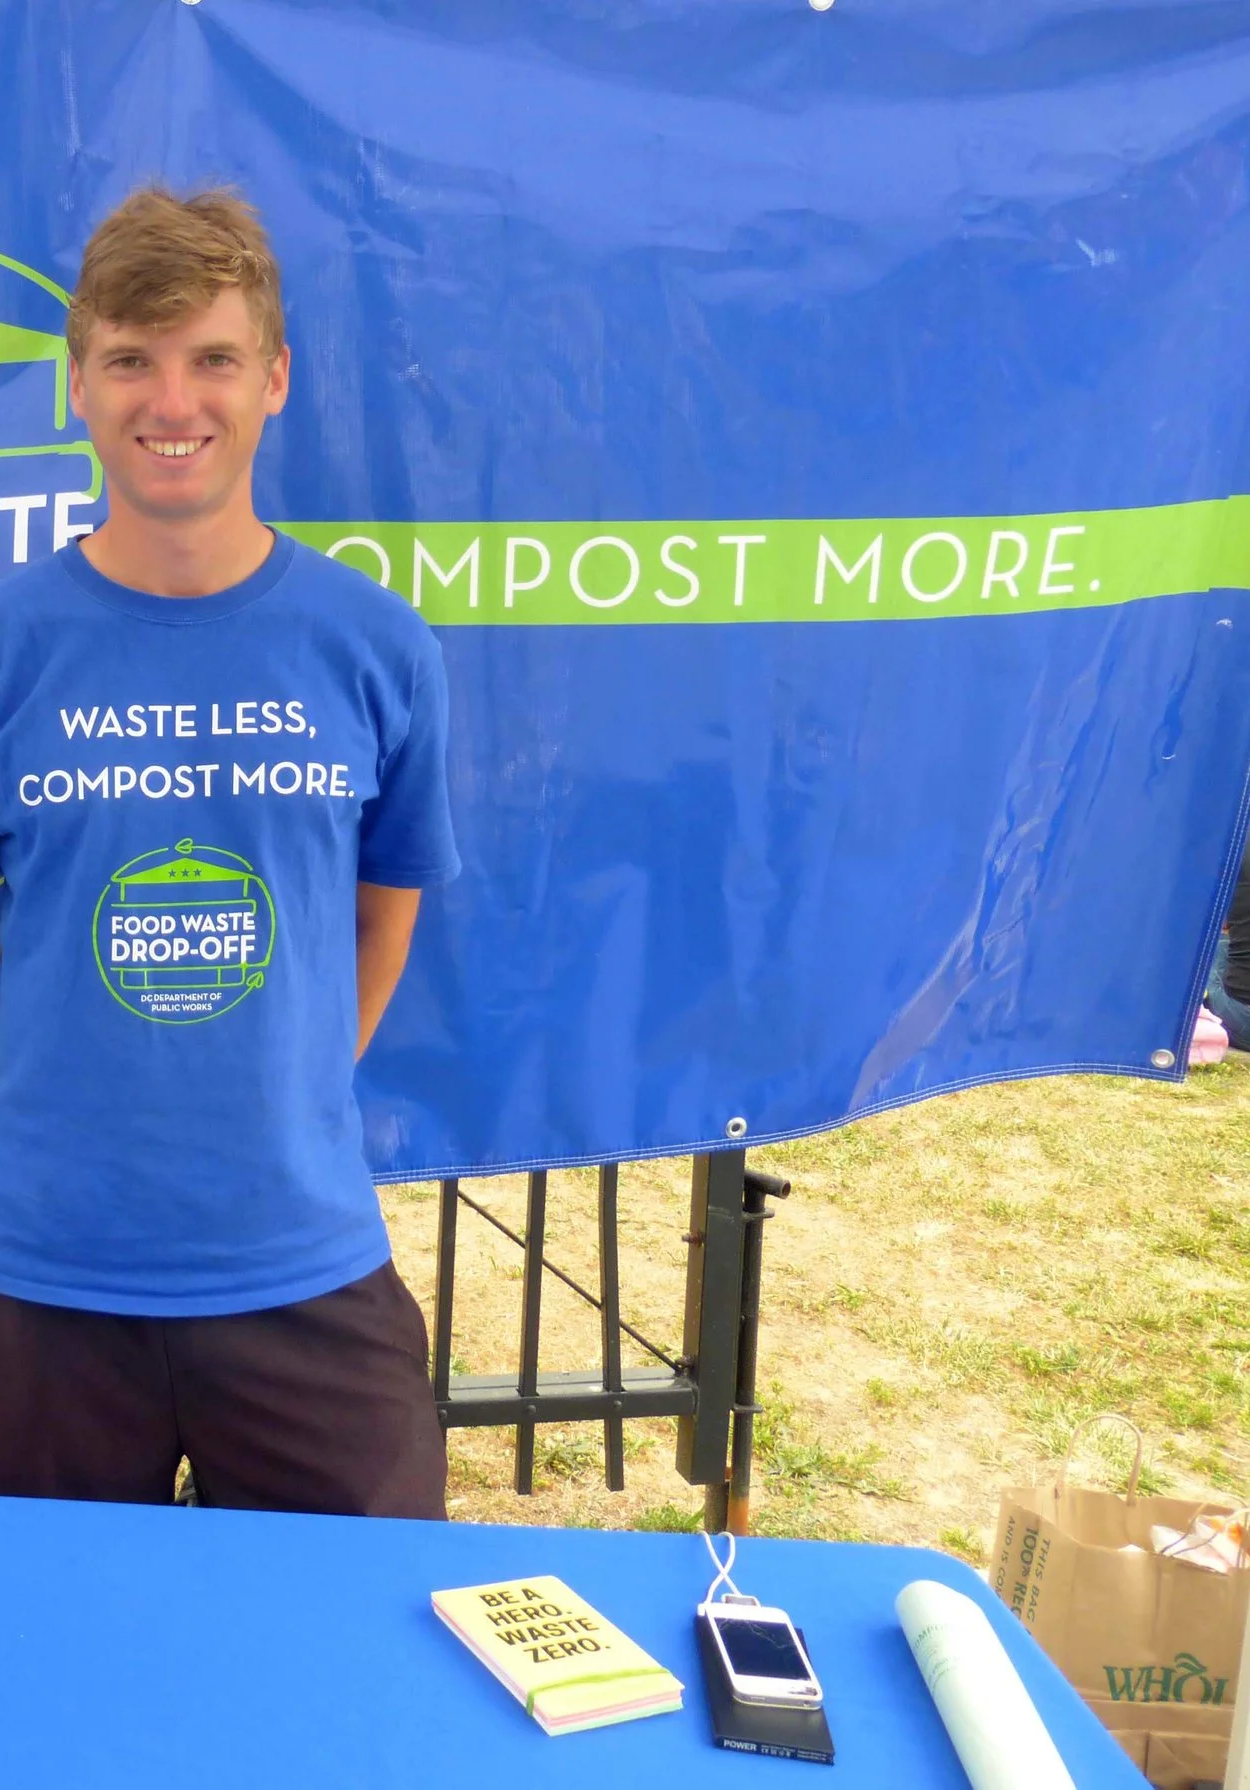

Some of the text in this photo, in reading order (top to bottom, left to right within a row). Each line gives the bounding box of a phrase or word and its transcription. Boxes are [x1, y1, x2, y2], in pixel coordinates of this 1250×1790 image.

[814, 525, 1101, 605] MORE.
[59, 700, 317, 740] WASTE LESS,
[18, 761, 356, 807] COMPOST MORE.
[111, 911, 256, 935] FOOD WASTE
[110, 934, 256, 964] DROP-OFF
[140, 992, 223, 1002] DC DEPARTMENT OF
[151, 1003, 213, 1012] PUBLIC WORKS
[1005, 1516, 1015, 1546] AND
[1001, 1550, 1010, 1564] IS
[1020, 1527, 1039, 1577] 100%
[1036, 1539, 1050, 1580] THIS
[478, 1588, 544, 1607] BE A
[1028, 1586, 1040, 1621] BAG
[485, 1603, 573, 1627] HERO.
[494, 1617, 600, 1646] WASTE
[522, 1637, 611, 1664] ZERO.
[723, 1739, 758, 1752] POWER
